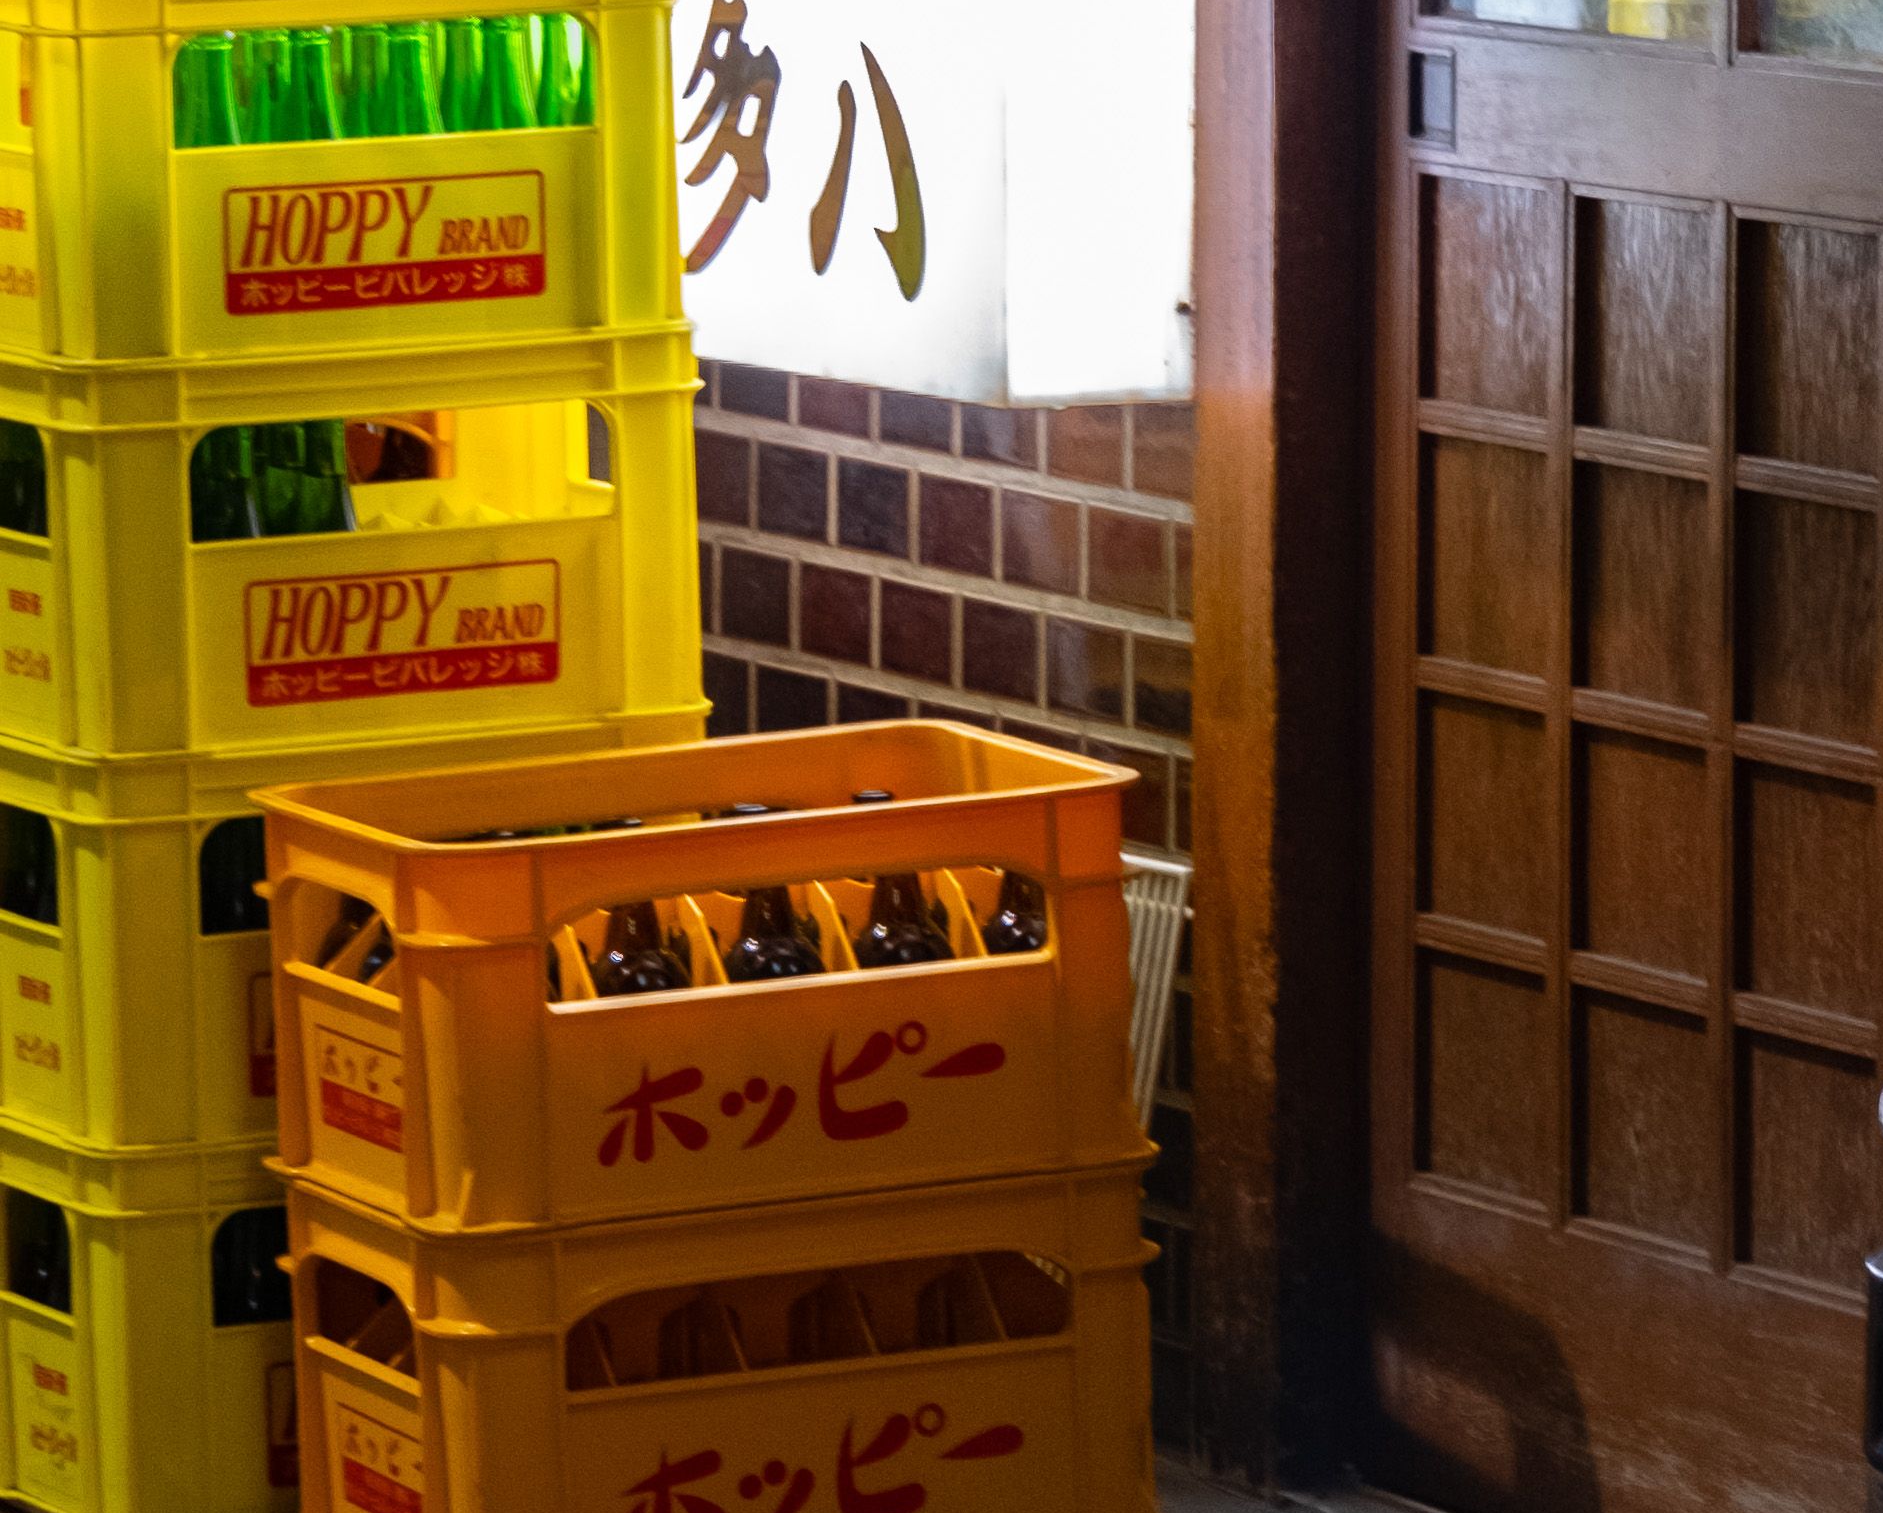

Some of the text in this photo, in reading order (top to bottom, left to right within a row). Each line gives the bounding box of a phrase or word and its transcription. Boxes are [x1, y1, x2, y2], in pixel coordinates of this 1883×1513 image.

[239, 185, 531, 268] HOPPY BRAND
[259, 575, 546, 661] HOPPY BRAND
[598, 1020, 1006, 1168] ホッピー
